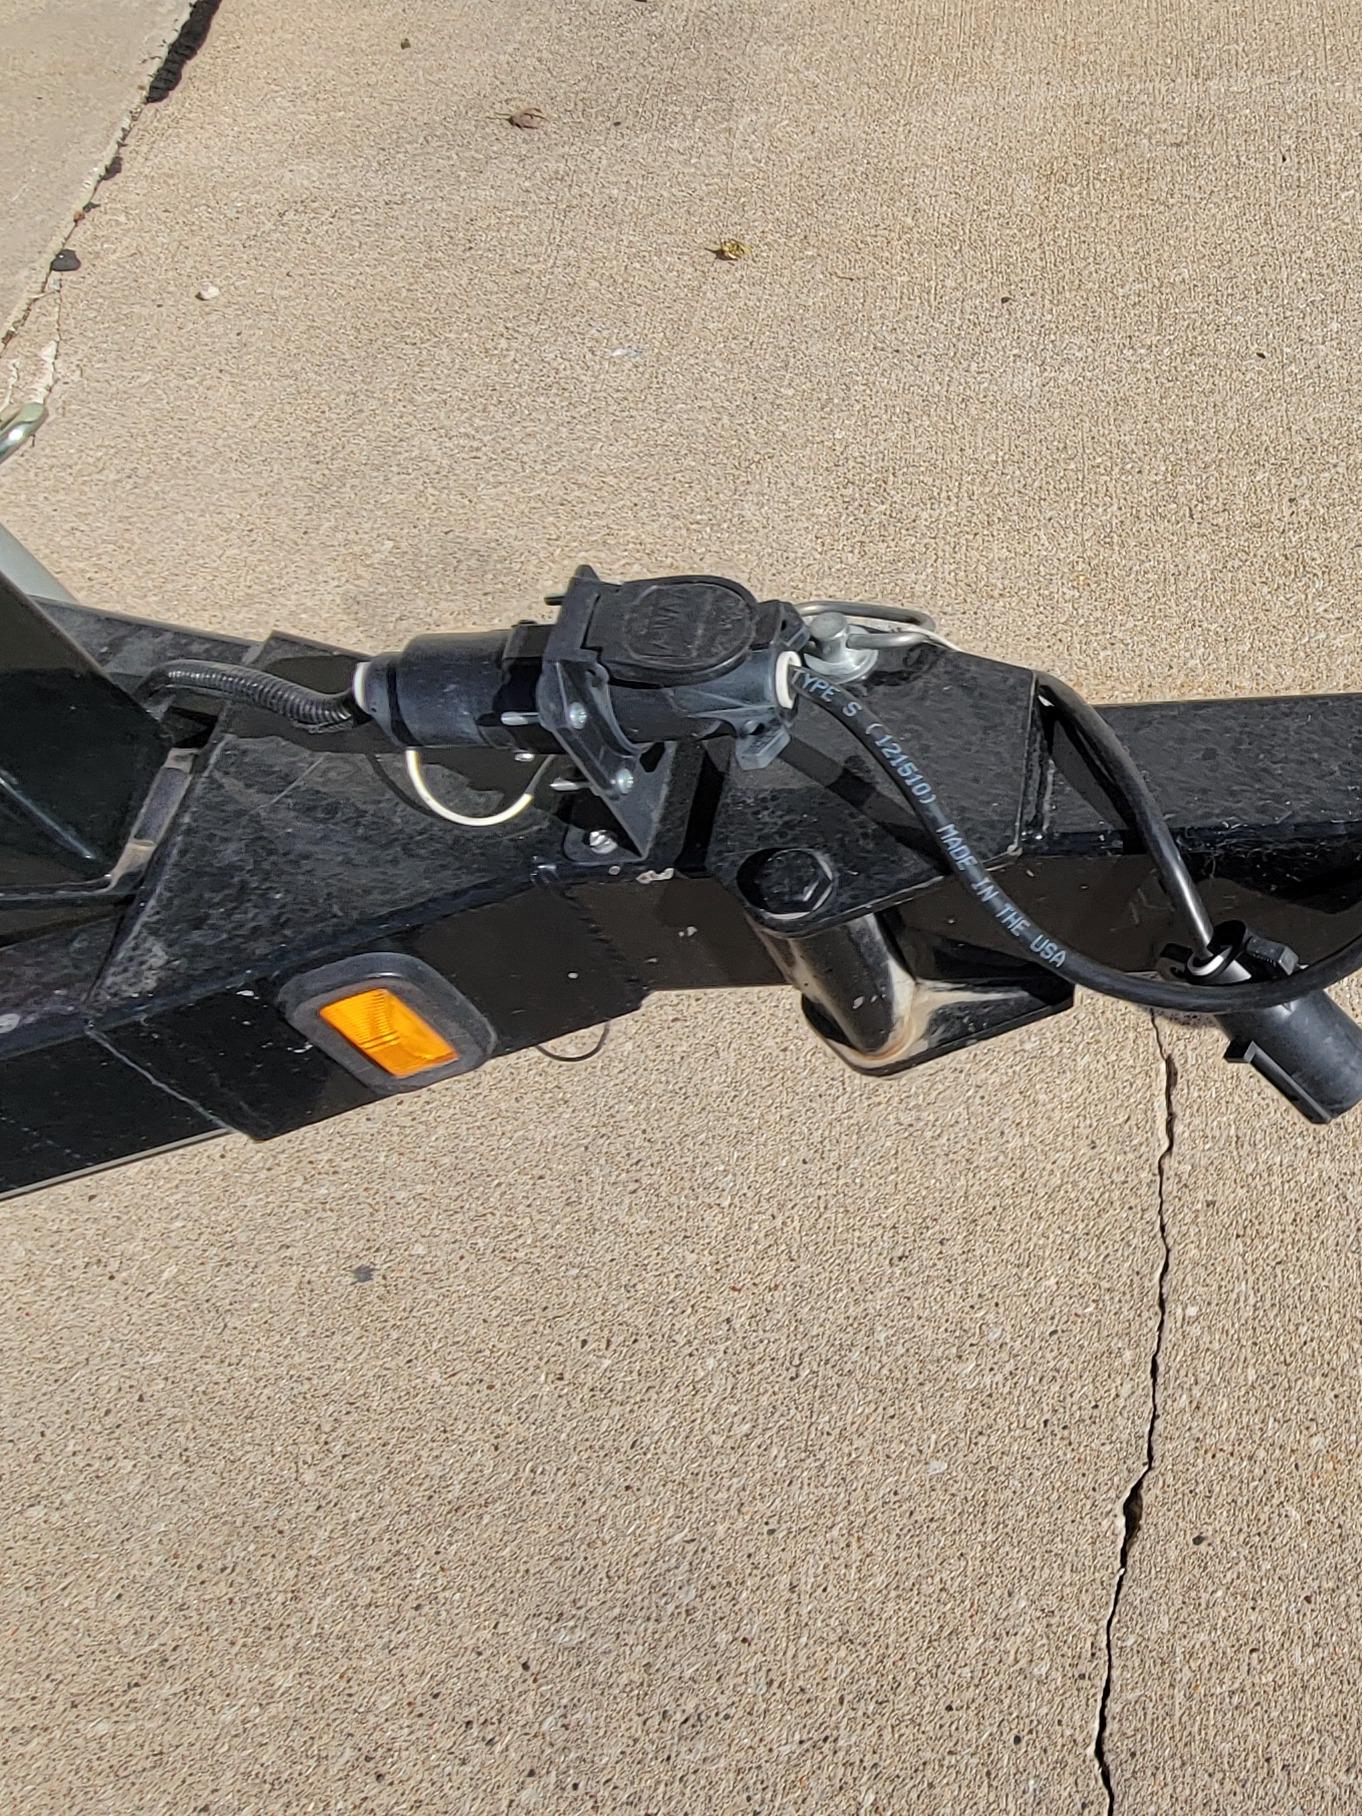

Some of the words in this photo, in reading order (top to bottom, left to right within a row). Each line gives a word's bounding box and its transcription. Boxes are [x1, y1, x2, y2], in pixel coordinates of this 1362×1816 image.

[791, 669, 841, 703] TYPE
[842, 701, 863, 718] S
[936, 823, 979, 872] MADE
[971, 876, 1000, 903] IN
[995, 903, 1032, 938] THE
[1029, 934, 1067, 968] USA
